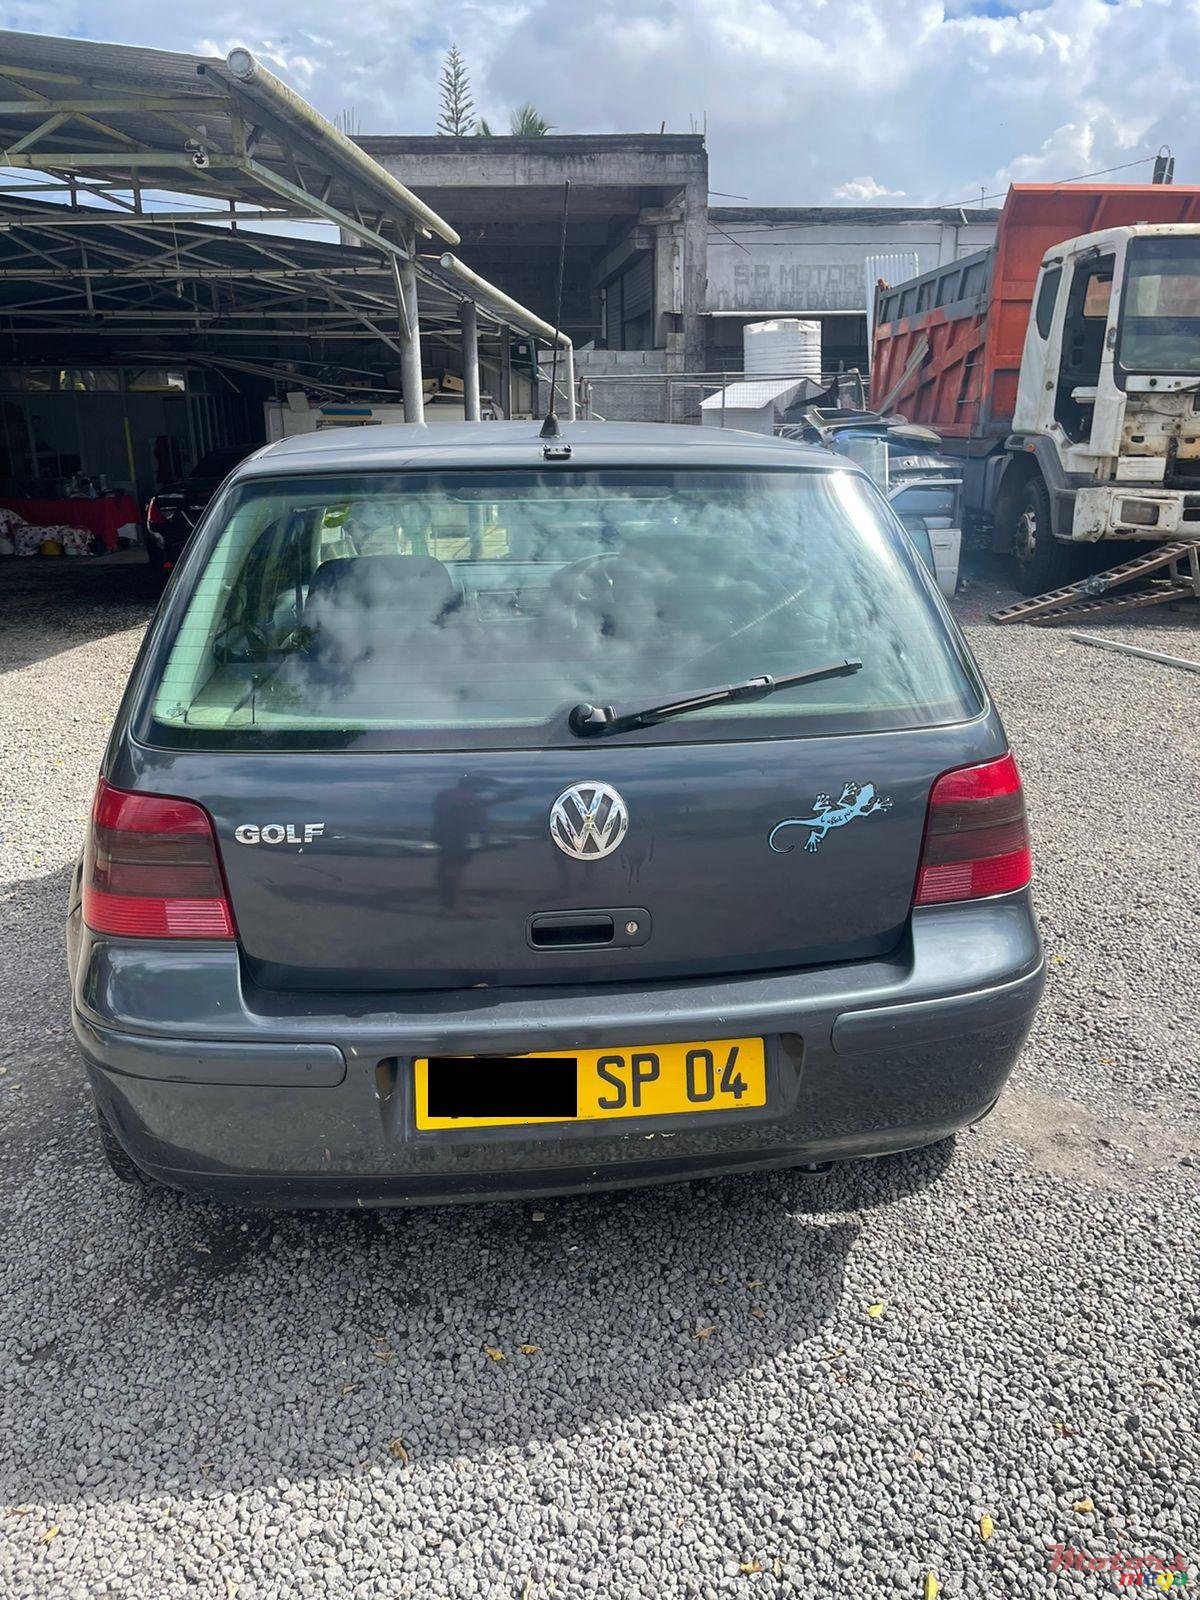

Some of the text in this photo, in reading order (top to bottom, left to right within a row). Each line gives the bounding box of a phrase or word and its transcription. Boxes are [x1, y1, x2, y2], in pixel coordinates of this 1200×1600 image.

[235, 823, 325, 844] GOLF
[597, 1047, 748, 1110] SP 04
